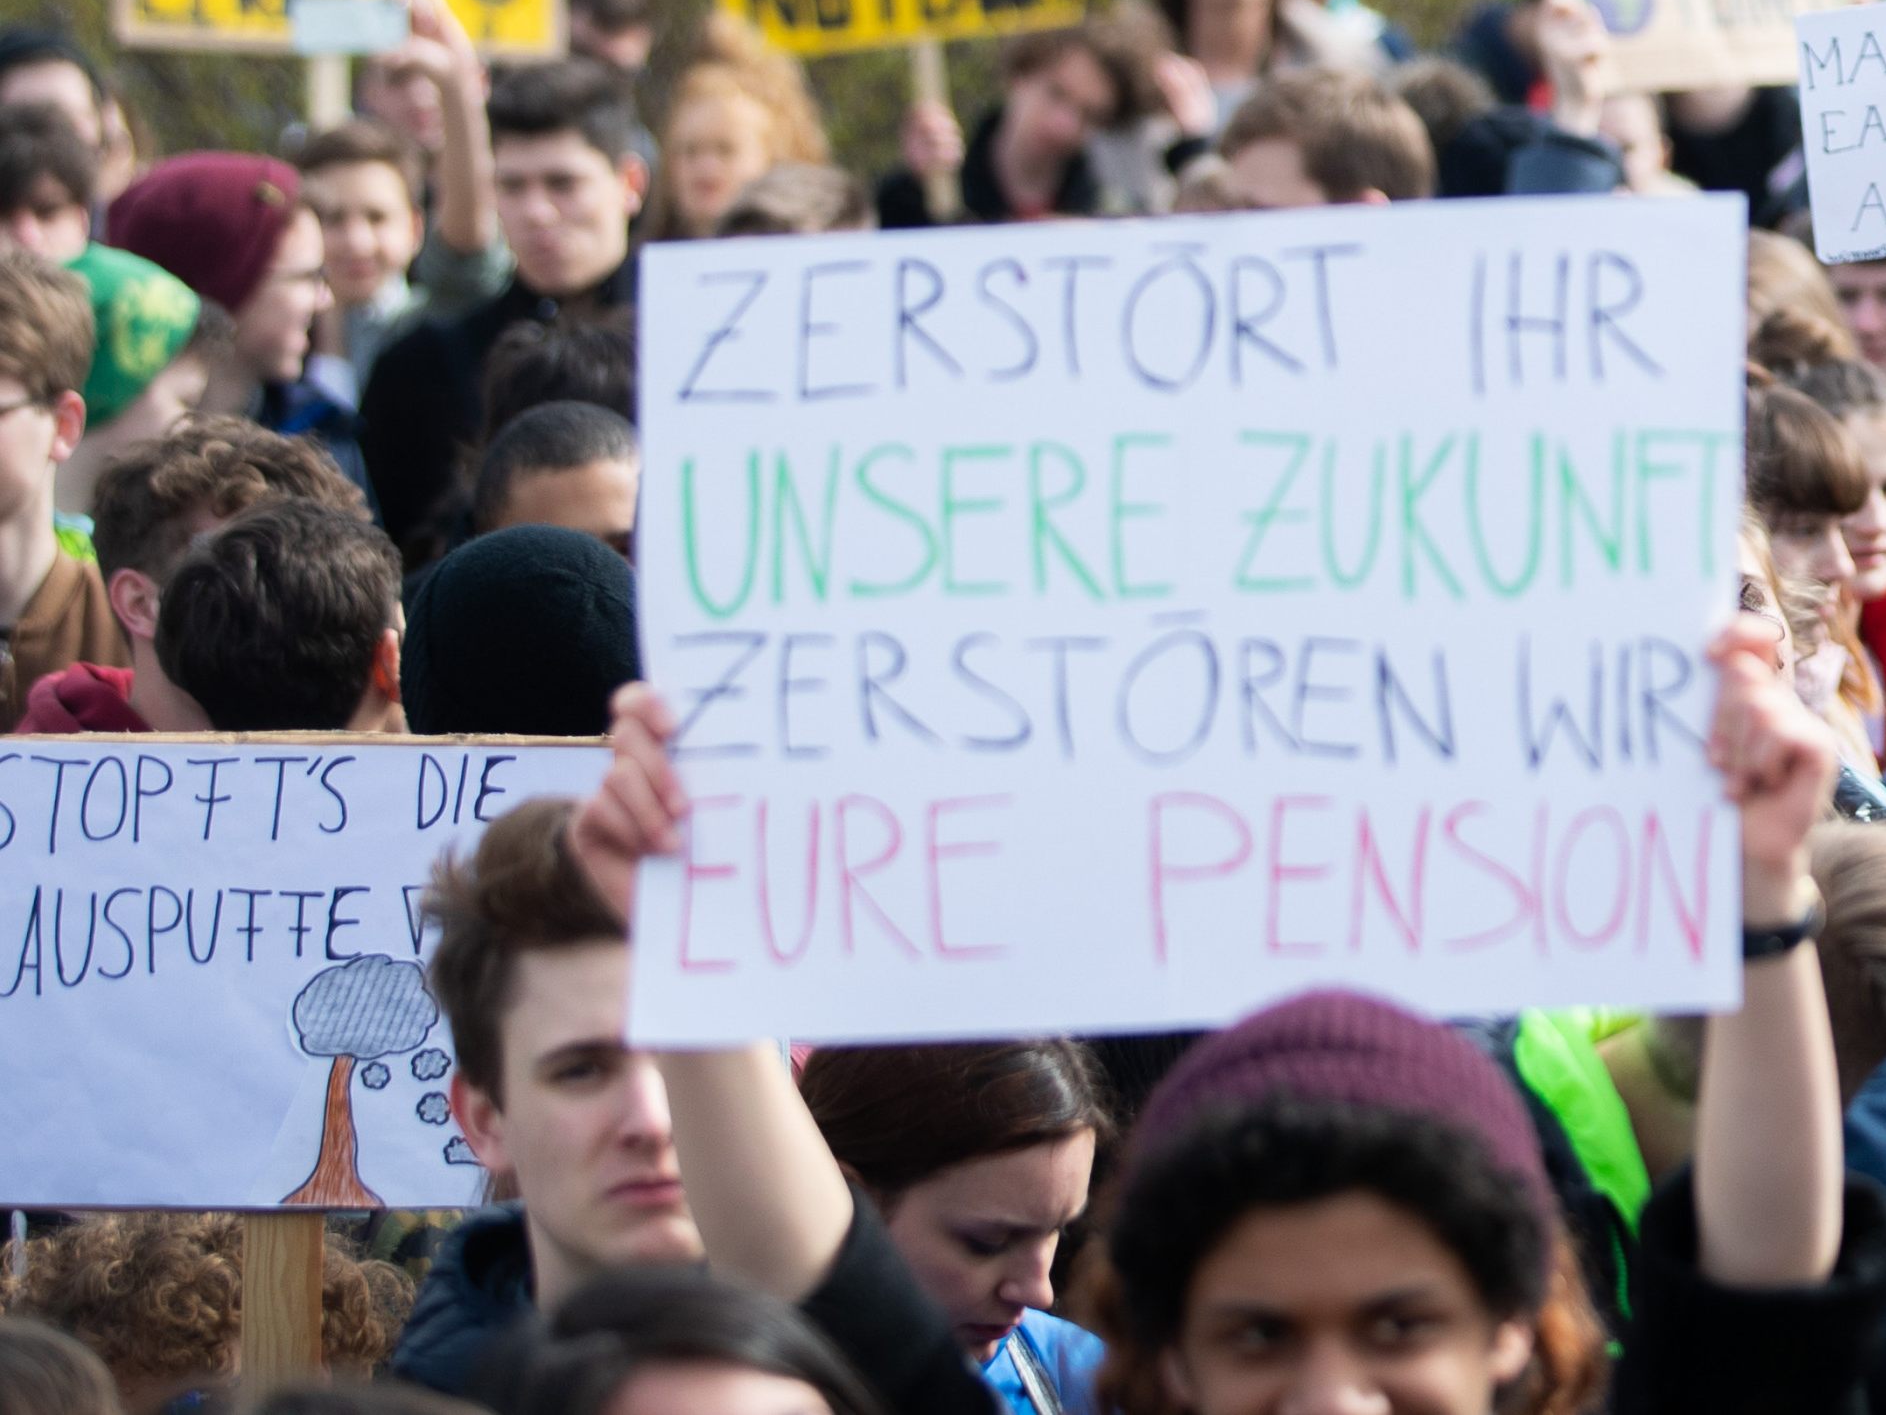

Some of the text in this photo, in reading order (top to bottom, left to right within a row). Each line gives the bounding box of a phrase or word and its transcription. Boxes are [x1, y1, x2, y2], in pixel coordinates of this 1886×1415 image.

[1470, 247, 1668, 397] IHR
[678, 426, 1740, 623] UNSERE ZUKUNFT
[1518, 631, 1708, 772] WIR
[416, 753, 517, 830] DIE
[674, 791, 1714, 973] EURE PENSION
